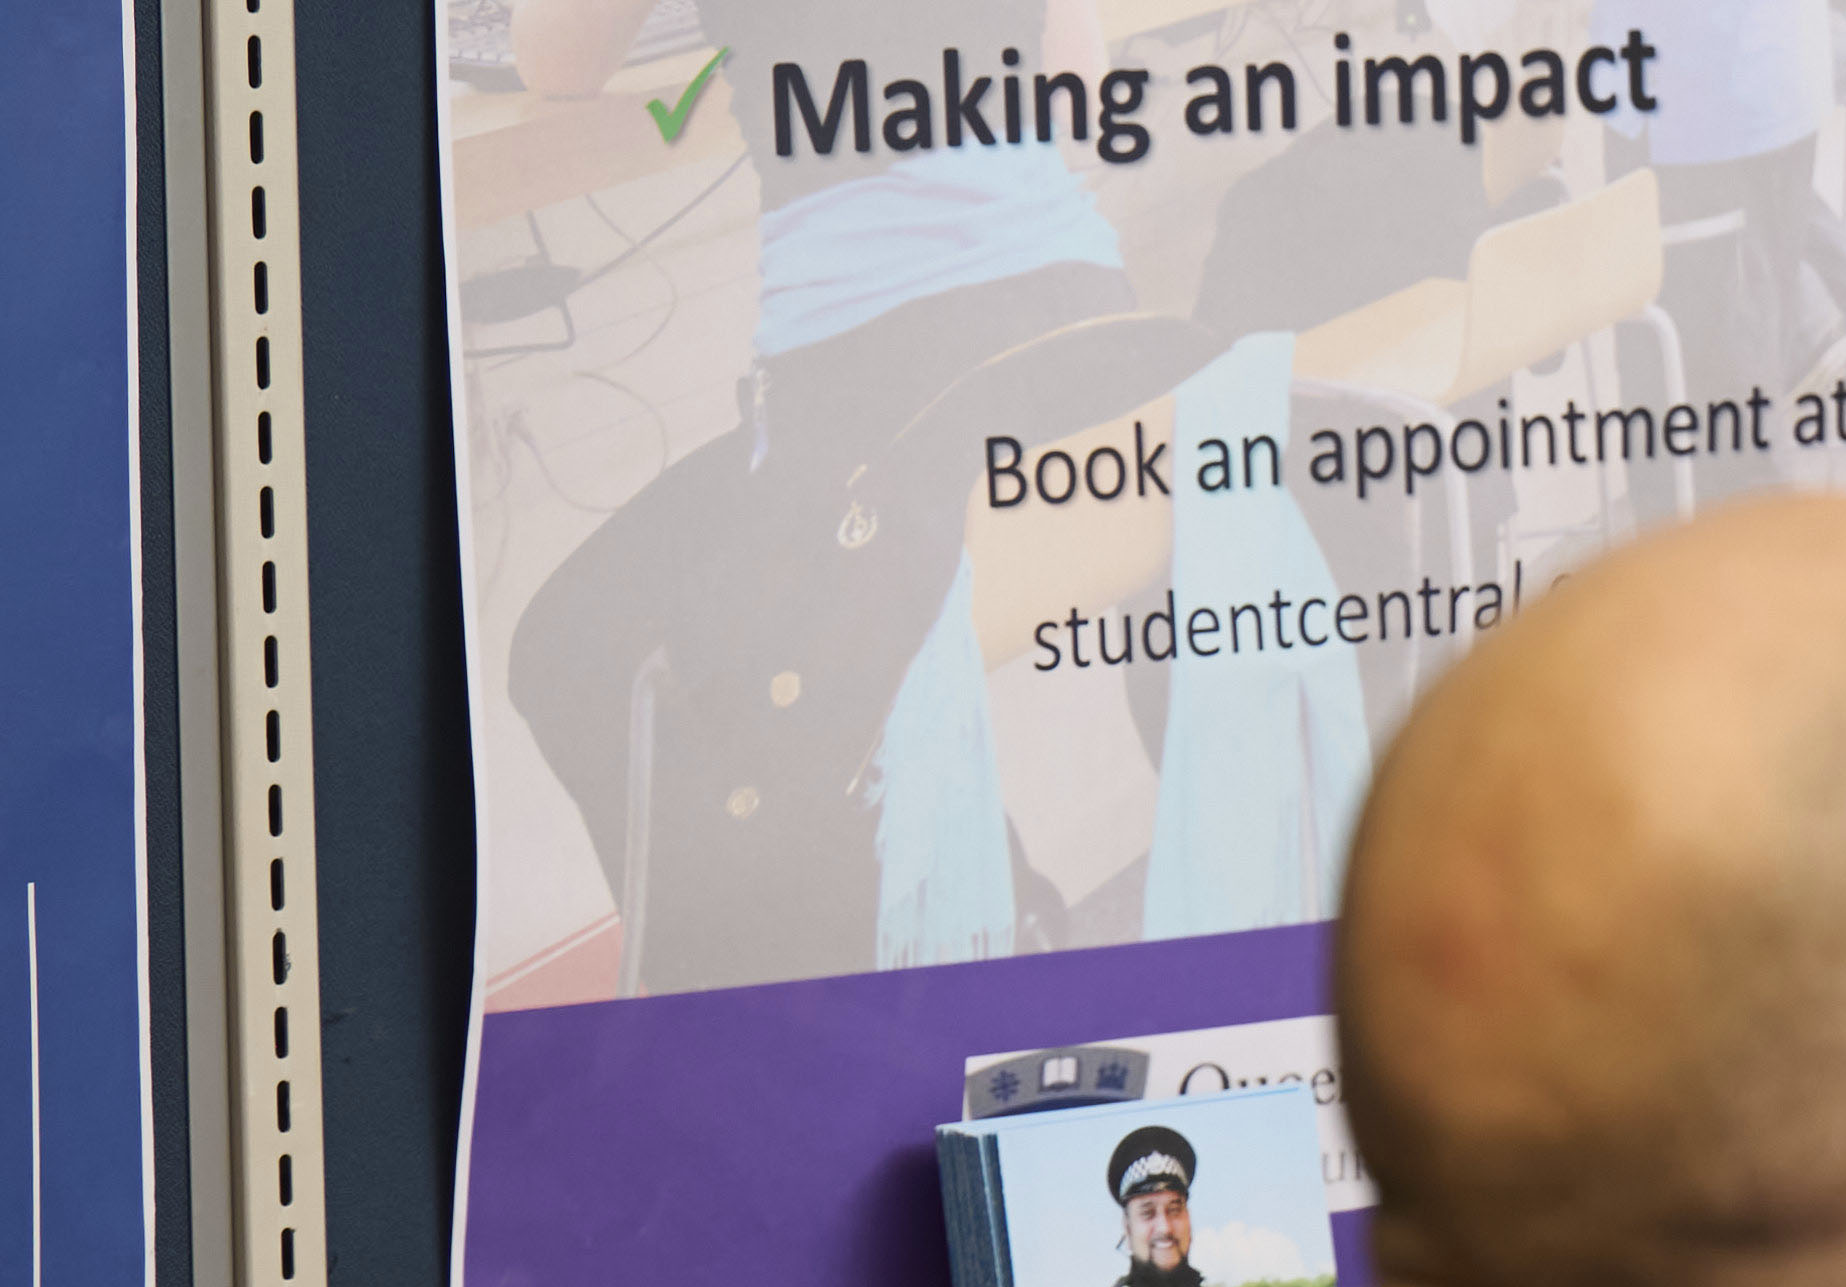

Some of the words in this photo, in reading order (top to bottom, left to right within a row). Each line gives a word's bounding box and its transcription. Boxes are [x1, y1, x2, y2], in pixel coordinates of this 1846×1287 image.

[773, 46, 1150, 163] Making
[1186, 63, 1295, 135] an
[1335, 31, 1656, 144] impact
[987, 420, 1169, 507] Book
[1199, 436, 1278, 491] an
[1311, 388, 1769, 500] appointment
[1036, 562, 1527, 670] studentcentral
